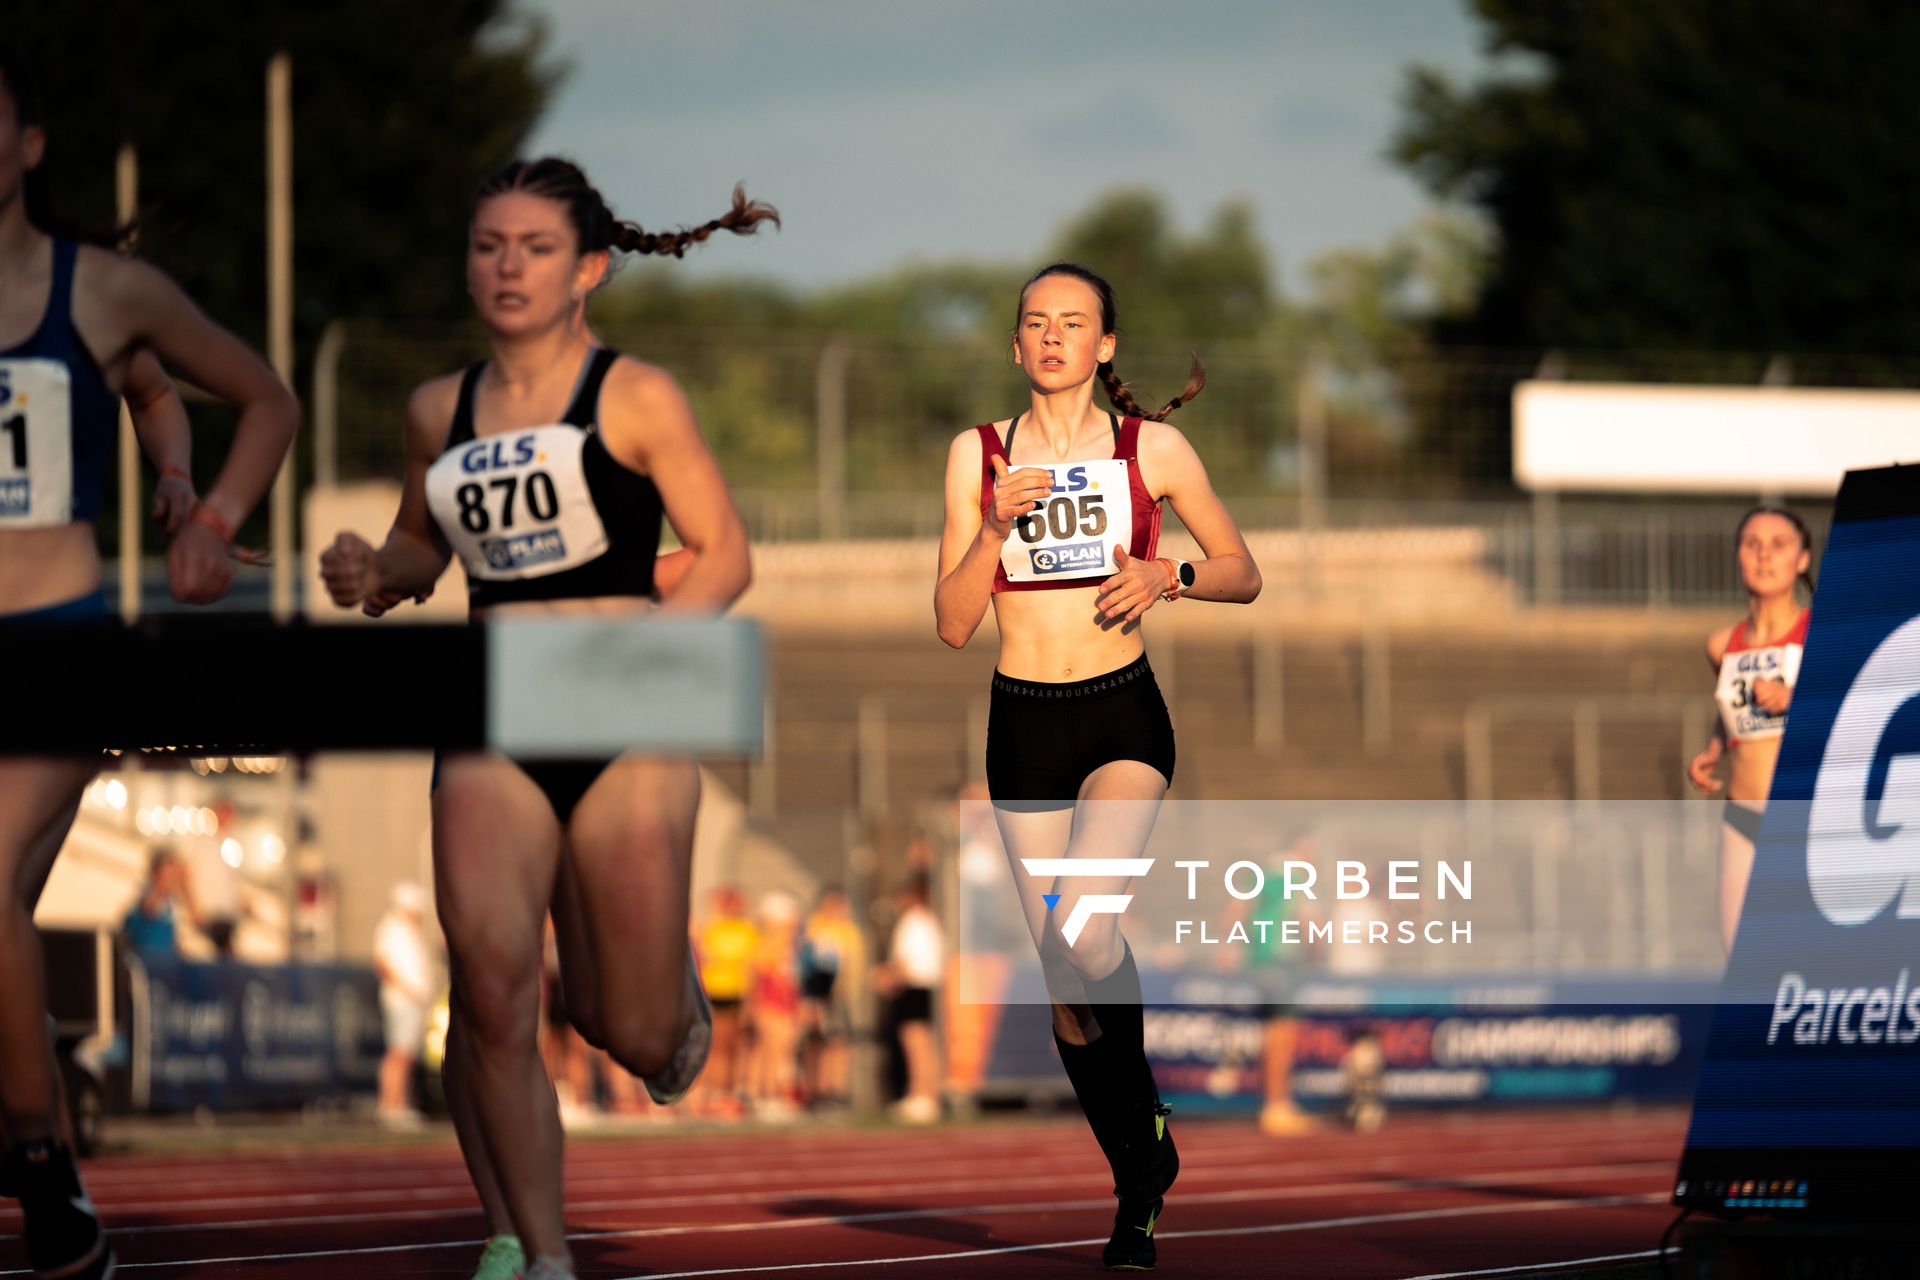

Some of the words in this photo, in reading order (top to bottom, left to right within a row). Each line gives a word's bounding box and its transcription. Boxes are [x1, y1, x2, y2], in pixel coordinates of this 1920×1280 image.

[1047, 466, 1099, 493] LS.
[457, 470, 559, 534] 870
[1017, 494, 1107, 543] 605
[1059, 546, 1102, 562] PLAN
[1038, 686, 1090, 699] ARMOUR
[1806, 612, 1920, 928] G
